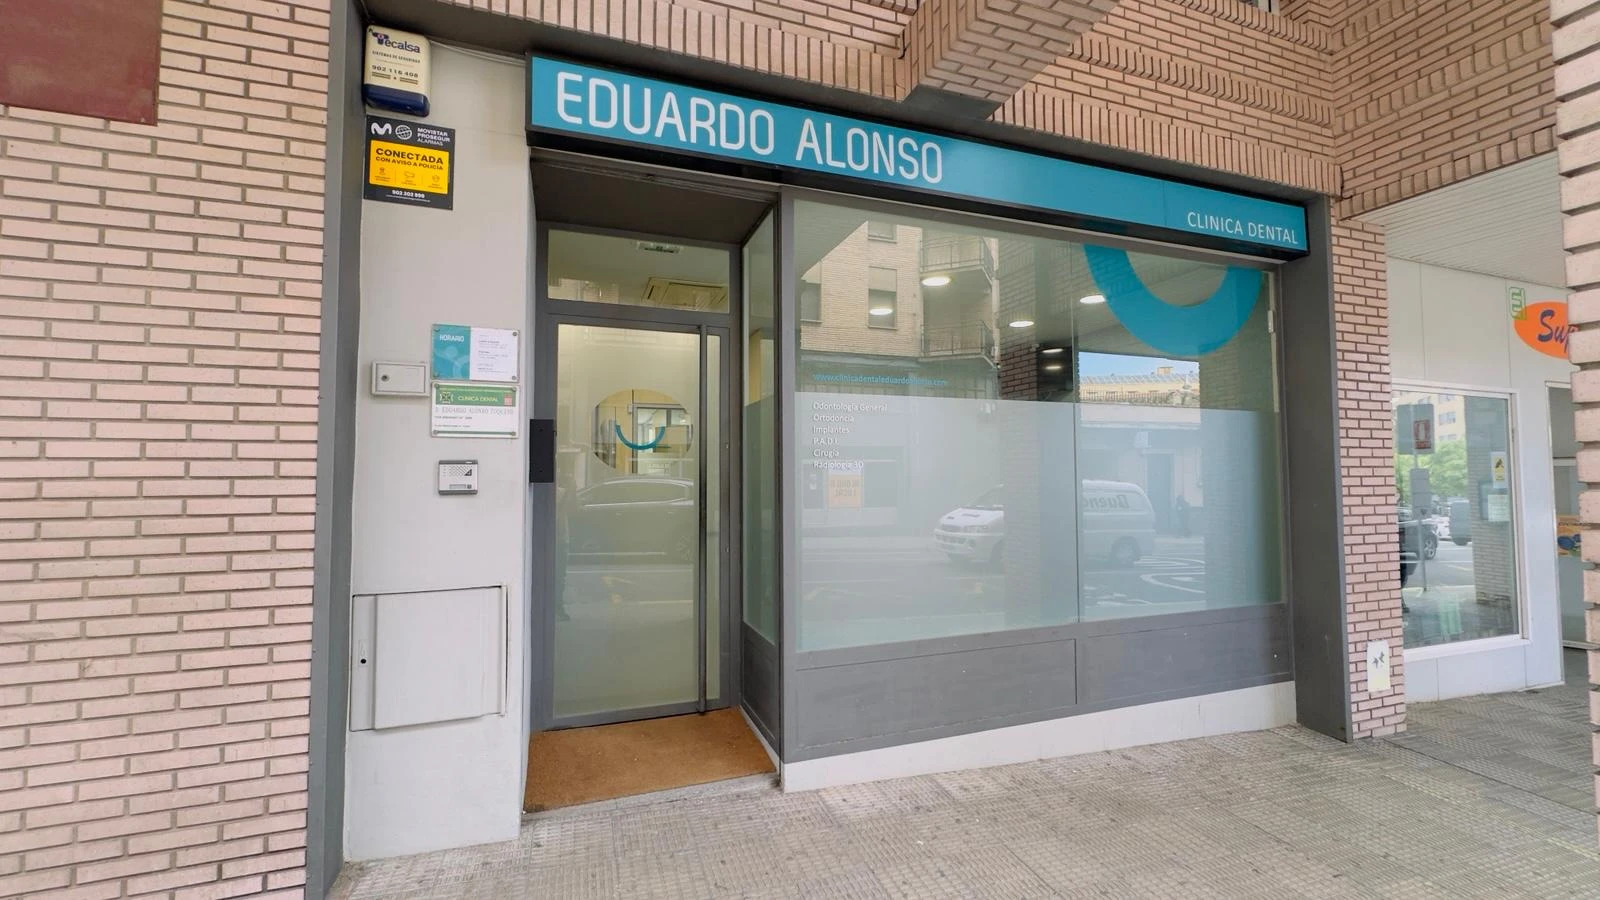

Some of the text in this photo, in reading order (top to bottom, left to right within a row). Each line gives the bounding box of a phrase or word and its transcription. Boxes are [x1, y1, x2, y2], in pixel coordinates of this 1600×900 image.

[417, 127, 448, 137] MOVISTAR
[556, 71, 943, 184] EDUARDO ALONSO
[417, 132, 451, 142] PROSEGUR
[417, 137, 444, 146] ALARMAS
[375, 147, 444, 165] CONECTADA
[391, 158, 412, 166] AVISO
[1187, 211, 1298, 245] CLINICA DENTAL
[439, 334, 465, 342] HORARIO
[860, 402, 888, 412] General
[813, 414, 855, 423] Ortodoncia
[813, 425, 850, 436] Implantes
